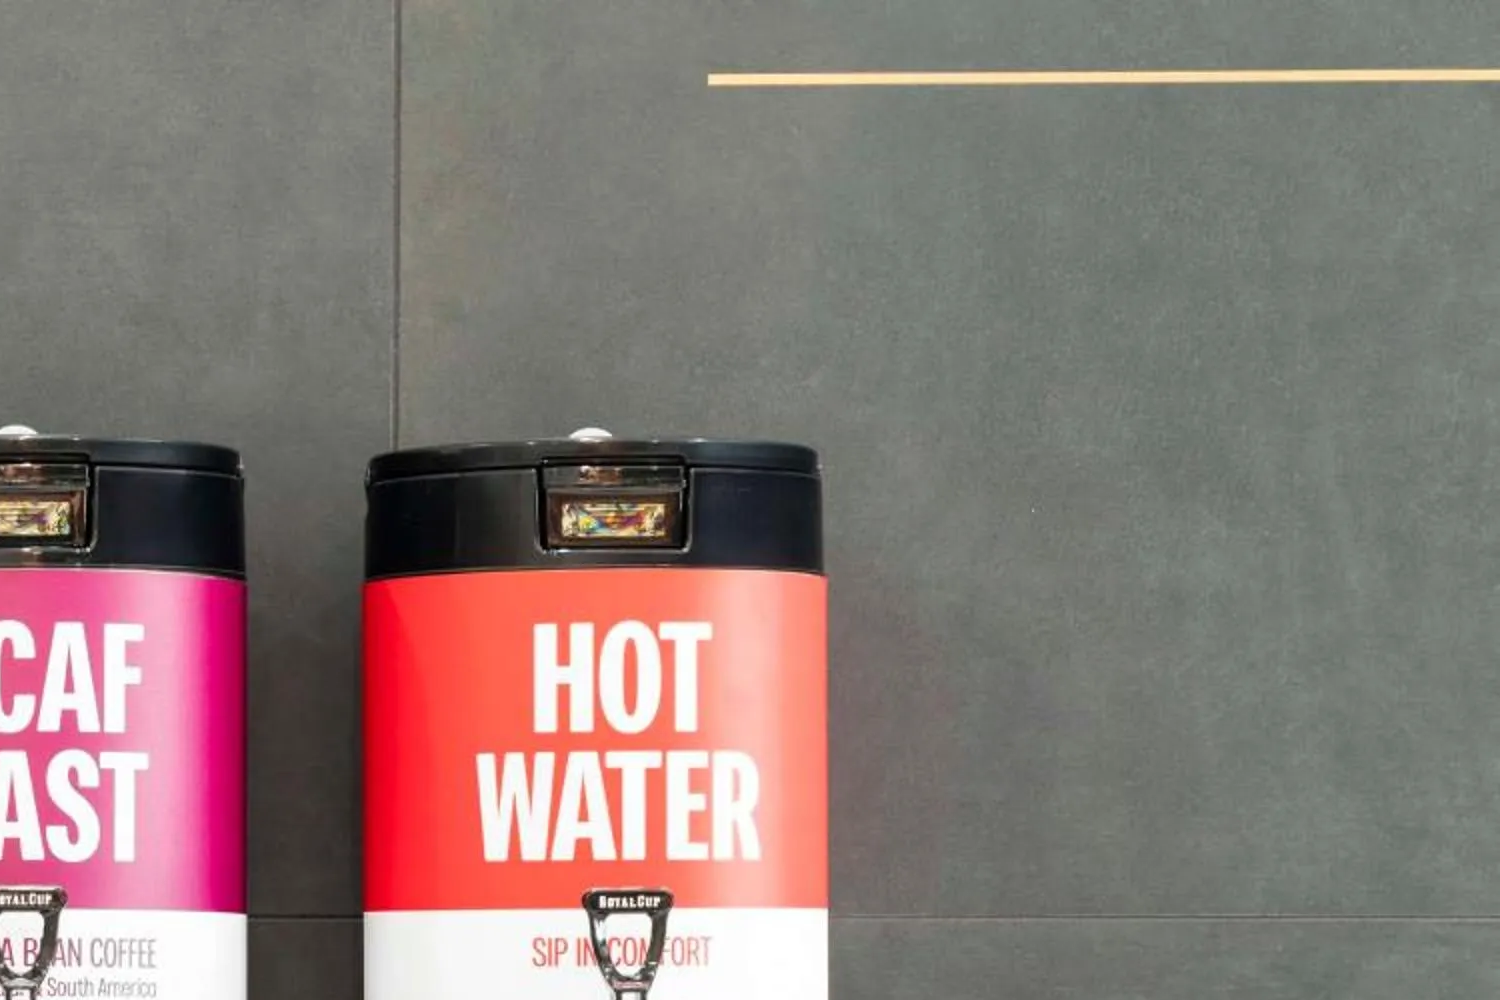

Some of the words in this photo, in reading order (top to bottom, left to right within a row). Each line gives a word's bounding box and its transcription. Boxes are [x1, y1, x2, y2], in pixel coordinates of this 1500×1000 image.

[532, 619, 714, 735] HOT
[475, 750, 762, 863] WATER
[23, 937, 83, 969] BAN
[90, 937, 157, 969] COFFEE
[532, 936, 569, 968] SIP
[576, 936, 598, 968] IN
[47, 976, 94, 998] South
[97, 977, 157, 998] America
